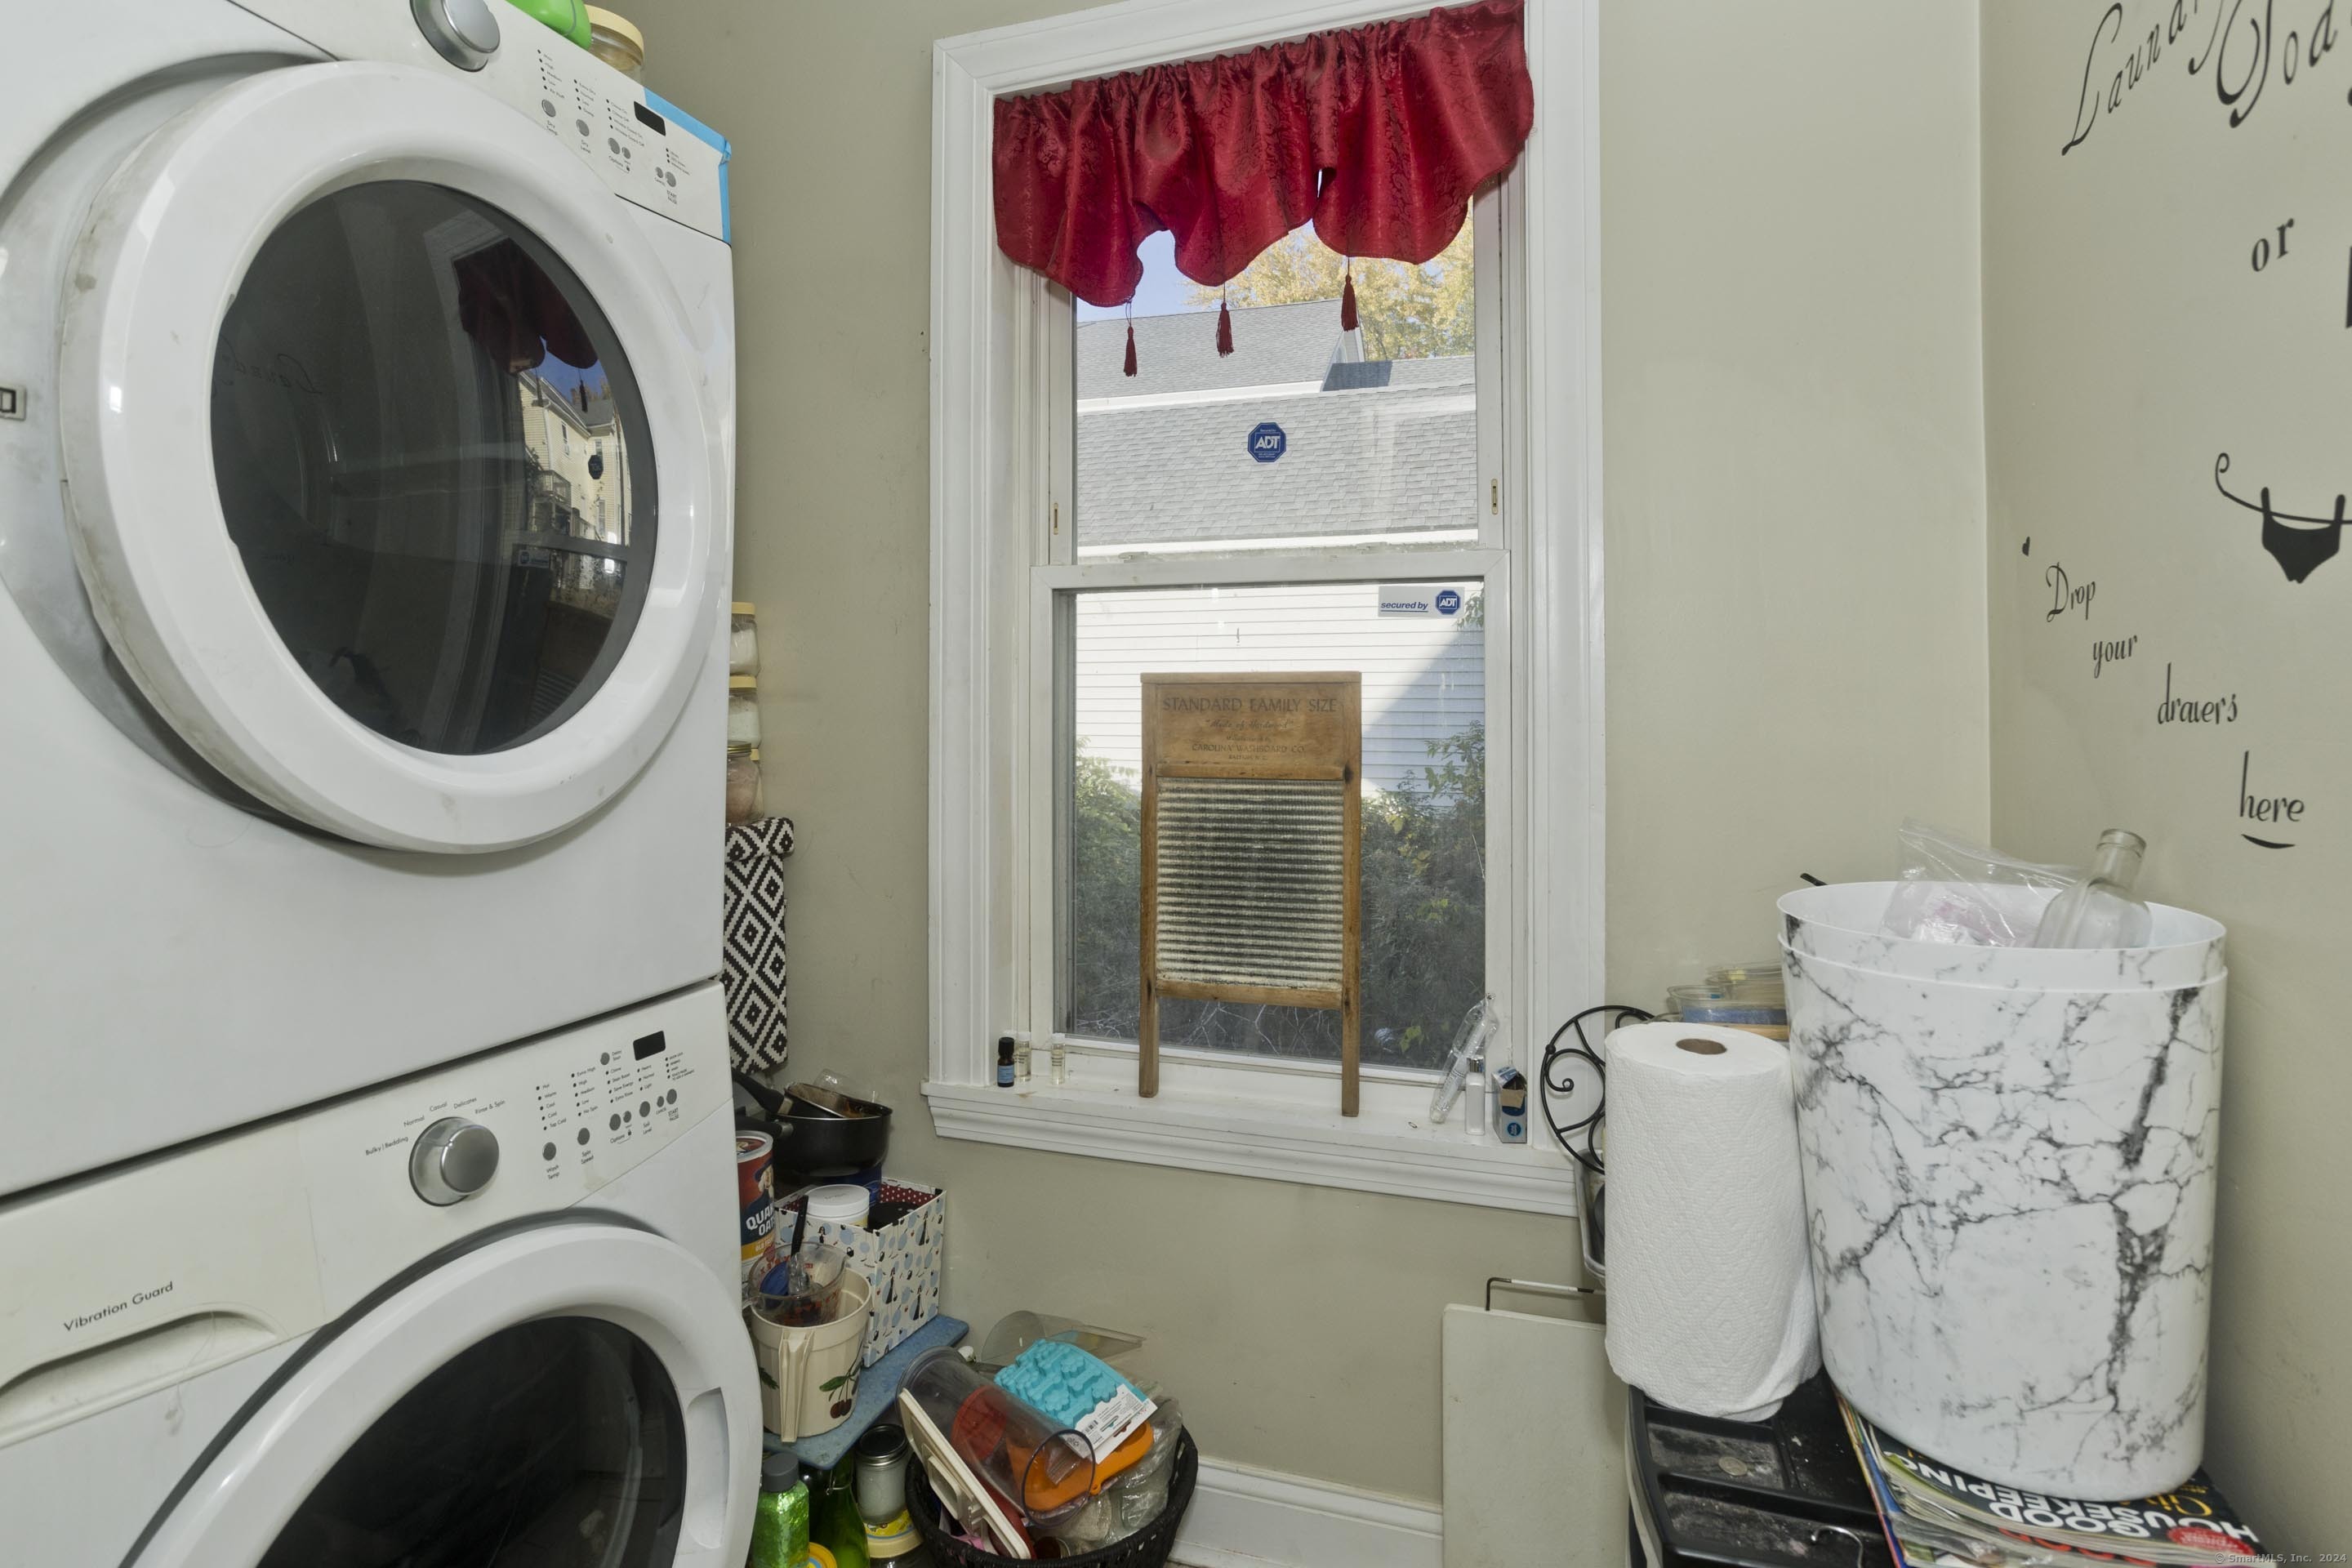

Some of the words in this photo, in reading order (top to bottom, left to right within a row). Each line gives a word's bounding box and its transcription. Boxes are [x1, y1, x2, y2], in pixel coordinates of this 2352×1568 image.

[2061, 0, 2223, 156] Laund
[2252, 218, 2295, 272] or
[1254, 435, 1281, 449] ADT
[2046, 562, 2096, 623] Drop
[1380, 601, 1416, 609] secured
[1417, 601, 1428, 610] by
[1440, 598, 1458, 607] ADT
[2093, 635, 2138, 679] your
[1162, 697, 1243, 713] STANDARD
[1250, 697, 1302, 713] FAMILY
[1308, 697, 1338, 713] SIZE
[1192, 744, 1233, 753] CAROLINA
[2238, 750, 2305, 822] here
[429, 1102, 448, 1112] Casual
[453, 1097, 478, 1110] Delicates
[494, 1099, 506, 1108] Spin
[403, 1115, 425, 1128] Normal
[365, 1145, 381, 1156] Bulky
[385, 1136, 408, 1149] Bedding
[759, 1216, 775, 1236] OAT
[63, 1302, 128, 1332] Vibration
[131, 1281, 174, 1306] Guard
[1989, 1501, 2151, 1539] GOOD
